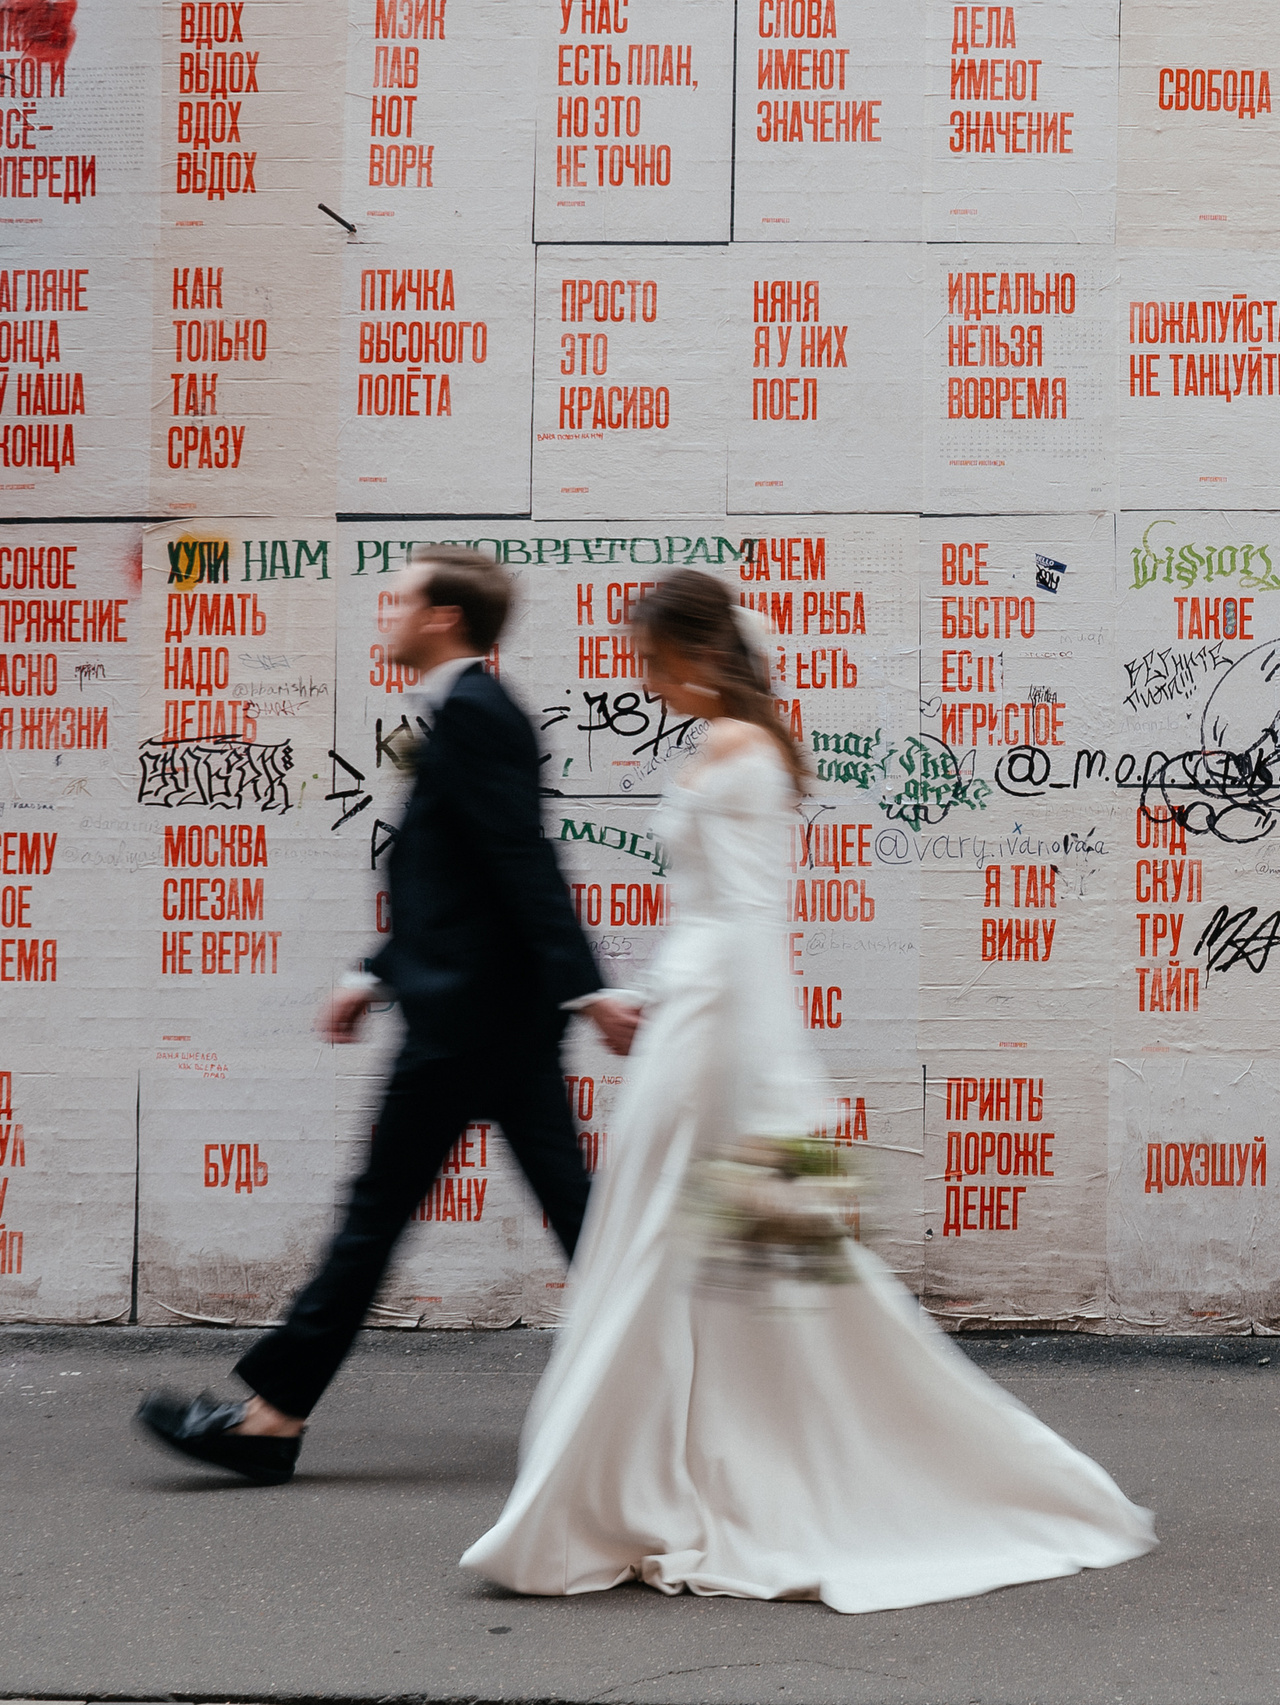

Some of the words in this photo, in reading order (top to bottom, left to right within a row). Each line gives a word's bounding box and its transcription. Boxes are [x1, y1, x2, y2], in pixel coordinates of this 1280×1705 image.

[180, 2, 245, 50] ВДОХ
[952, 7, 1015, 54] ДЕЛА
[179, 52, 260, 100] ВЫДОХ
[558, 45, 620, 86] ЕСТЬ
[628, 45, 697, 89] ПЛАН,
[951, 59, 1042, 100] ИМЕЮТ
[1159, 68, 1271, 119] СВОБОДА
[557, 96, 588, 137] НО
[594, 96, 640, 137] ЭТО
[950, 111, 1073, 153] ЗНАЧЕНИЕ
[557, 145, 587, 186] НЕ
[594, 145, 670, 186] ТОЧНО
[173, 267, 223, 309] КАК
[361, 269, 454, 310] ПТИЧКА
[562, 280, 656, 322] ПРОСТО
[754, 281, 818, 322] НЯНЯ
[173, 319, 266, 362] ТОЛЬКО
[359, 322, 487, 363] ВЫСОКОГО
[561, 333, 607, 375] ЭТО
[754, 326, 769, 367] Я
[778, 326, 791, 367] У
[801, 326, 847, 367] НИХ
[170, 373, 218, 415] ТАК
[1130, 354, 1160, 396] НЕ
[560, 387, 669, 429] КРАСИВО
[753, 378, 817, 420] ПОЕЛ
[168, 425, 245, 469] СРАЗУ
[241, 540, 331, 582] НАМ
[942, 543, 988, 585] ВСЕ
[165, 593, 266, 643] ДУМАТЬ
[942, 597, 1035, 638] БЫСТРО
[164, 647, 228, 696] НАДО
[164, 825, 267, 867] МОСКВА
[163, 878, 263, 920] СЛЕЗАМ
[984, 865, 1000, 907] Я
[1011, 865, 1056, 907] ТАК
[1136, 860, 1201, 902] СКУЛ
[162, 932, 193, 974] НЕ
[202, 932, 281, 974] ВЕРИТ
[982, 919, 1056, 961] ВИЖУ
[1136, 914, 1184, 956] ТРУ
[1136, 961, 1199, 1012] ТАЙП
[946, 1078, 1043, 1121] ПРИНТЫ
[204, 1144, 267, 1193] БУДЬ
[944, 1132, 1054, 1182] ДОРОЖЕ
[1145, 1137, 1266, 1193] ДОХЭШУЙ
[943, 1186, 1026, 1237] ДЕНЕГ
